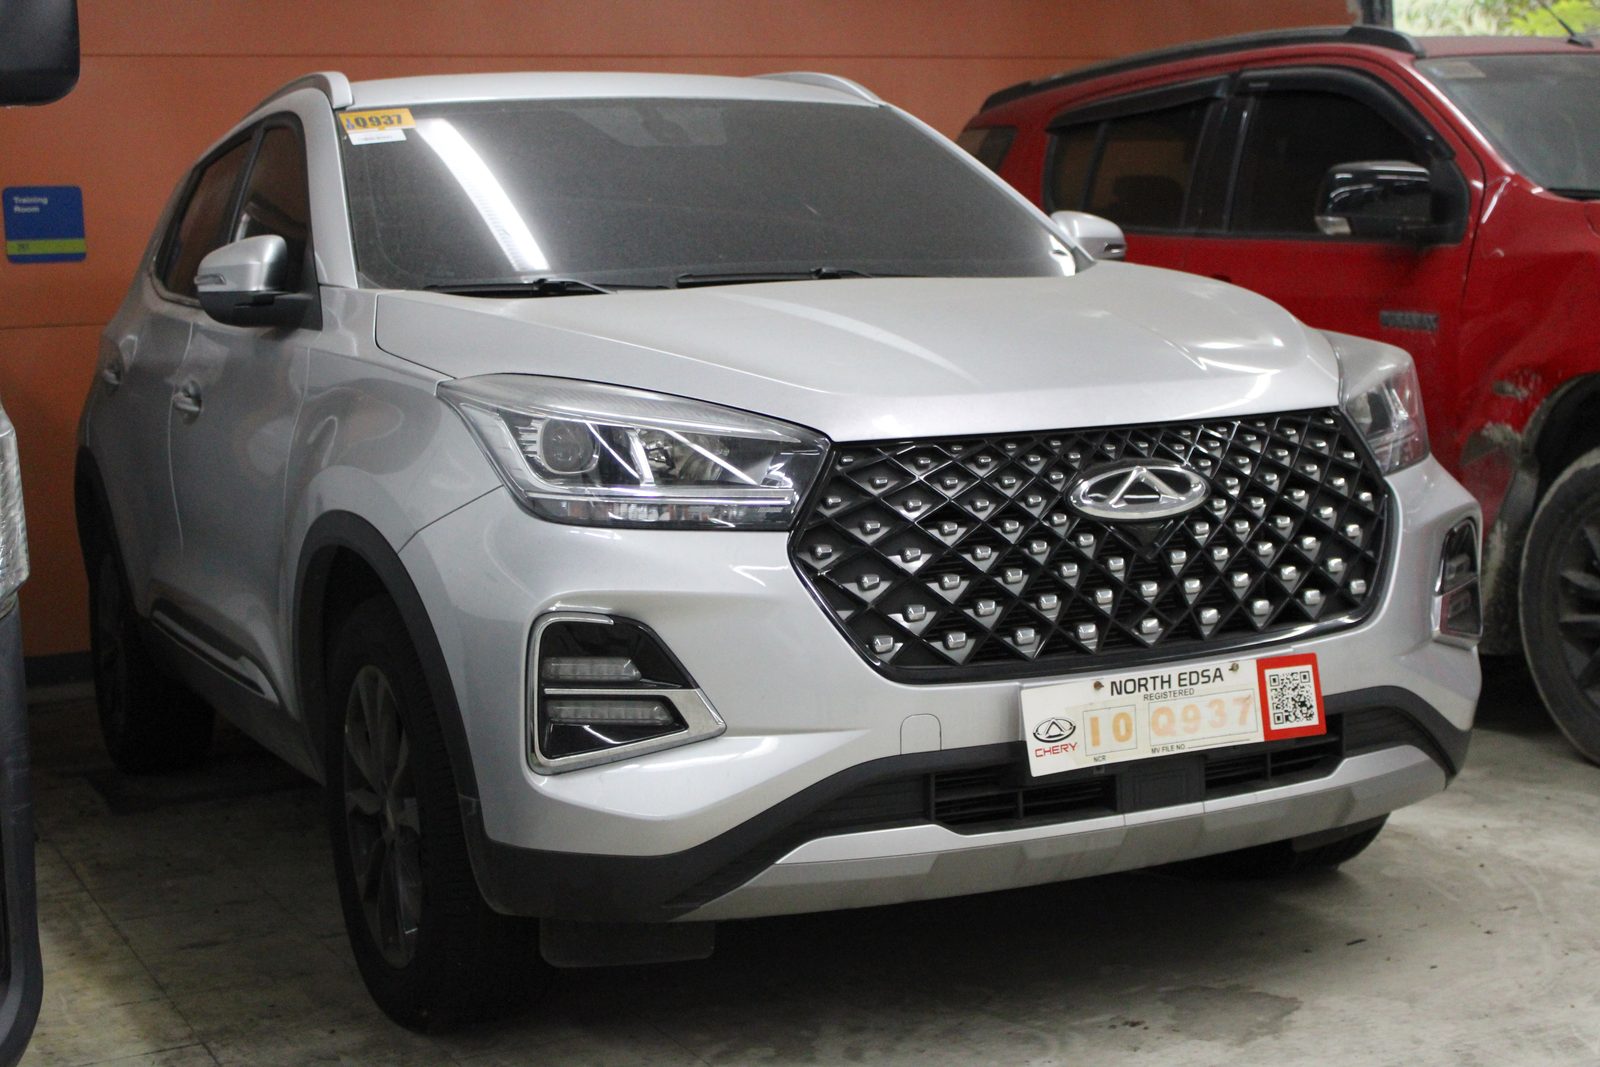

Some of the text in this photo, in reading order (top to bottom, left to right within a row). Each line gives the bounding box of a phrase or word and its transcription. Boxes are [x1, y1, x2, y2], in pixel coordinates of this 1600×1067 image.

[1110, 667, 1224, 696] NORTH EDSA
[1143, 688, 1195, 701] REGISTERED
[1151, 694, 1252, 738] Q937
[1034, 742, 1078, 758] CHERY
